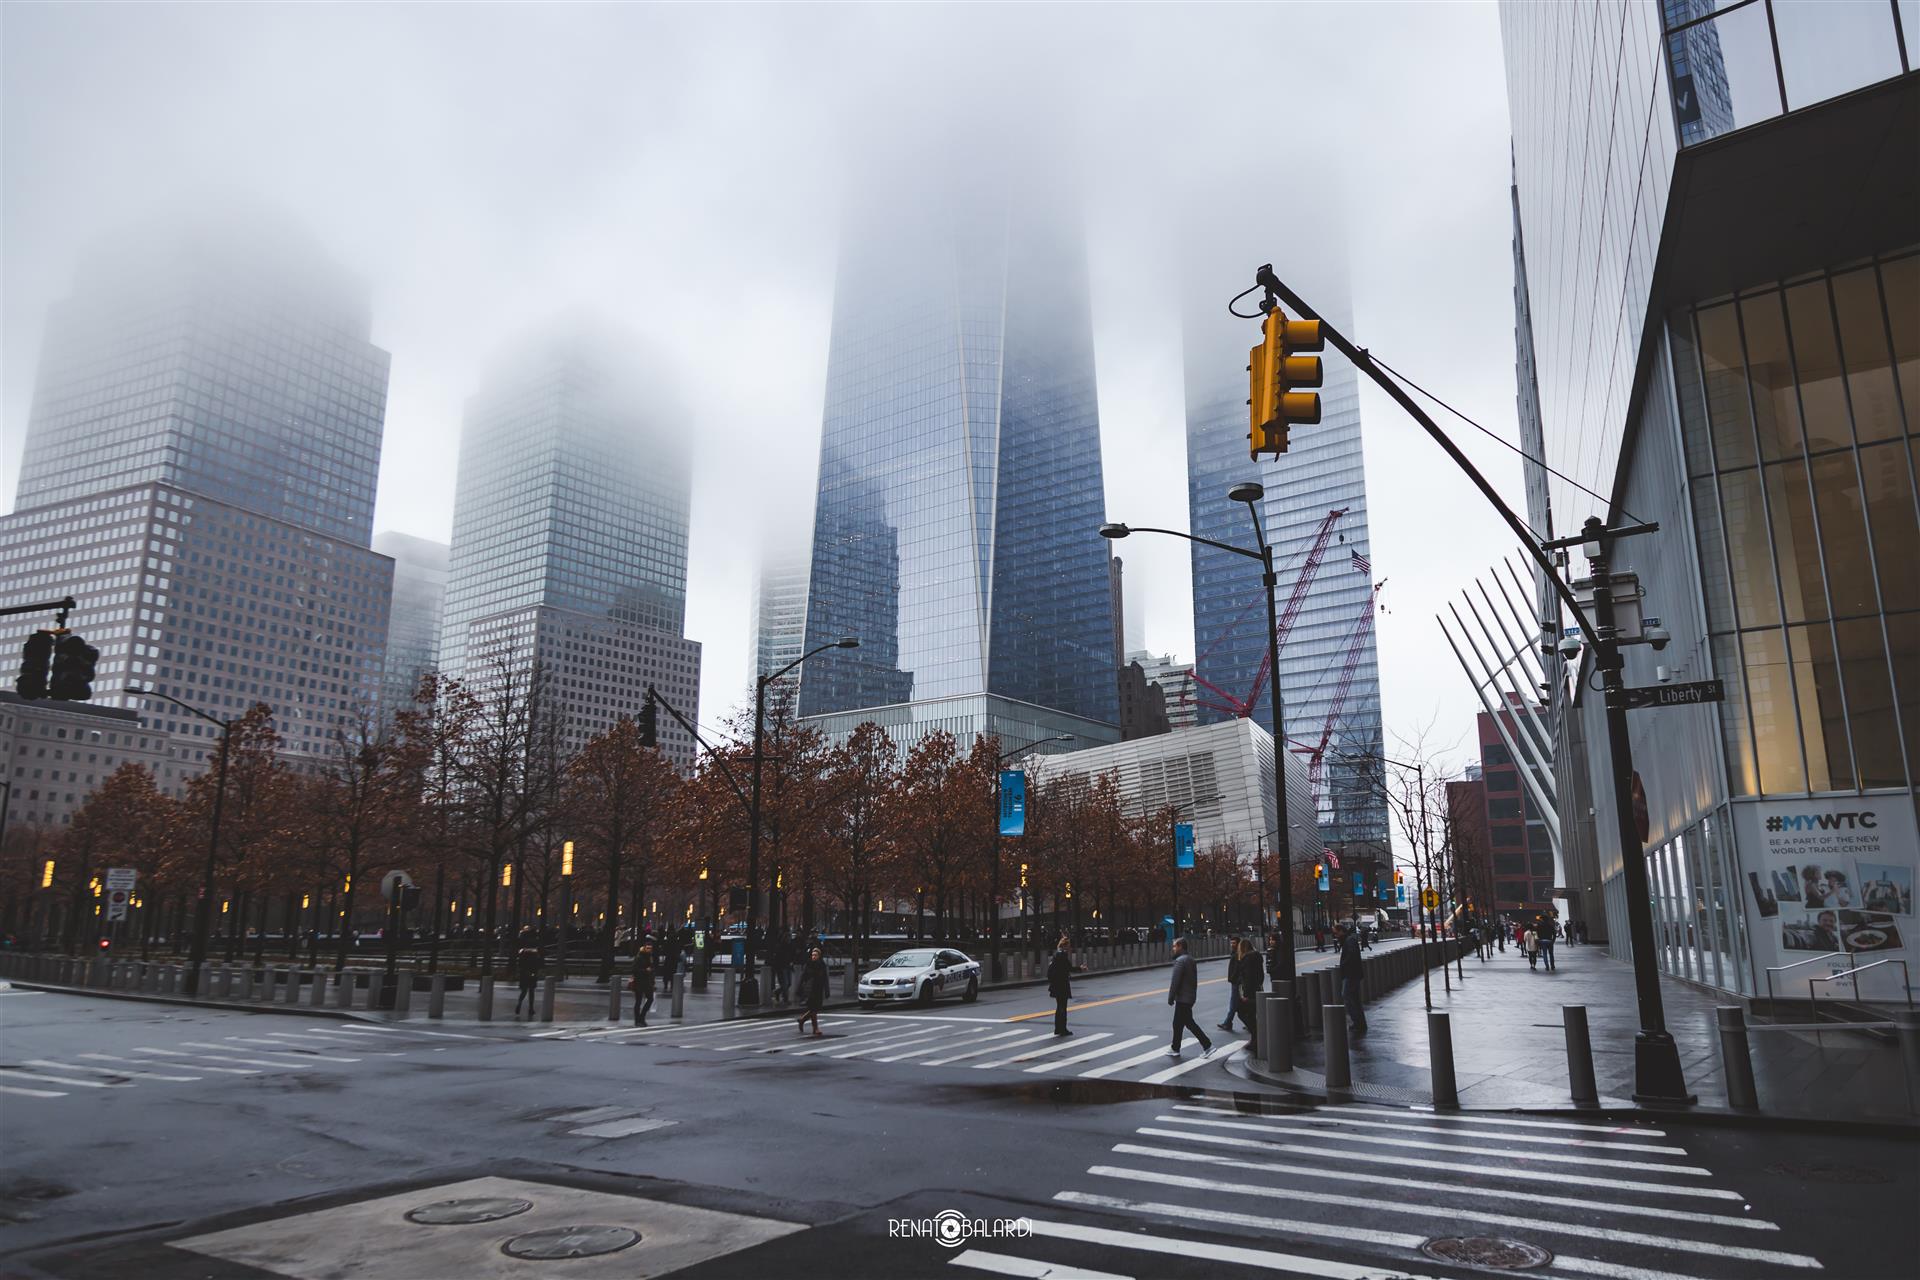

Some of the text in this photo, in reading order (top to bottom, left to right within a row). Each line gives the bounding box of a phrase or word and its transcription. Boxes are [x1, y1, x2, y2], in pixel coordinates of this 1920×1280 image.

[1660, 685, 1716, 703] Liberty St
[1766, 812, 1877, 832] #MYWTC
[1769, 838, 1781, 846] BE
[1793, 837, 1817, 845] PART
[1819, 836, 1833, 844] OF
[1770, 847, 1806, 855] WORLD
[1841, 845, 1880, 853] CENTER
